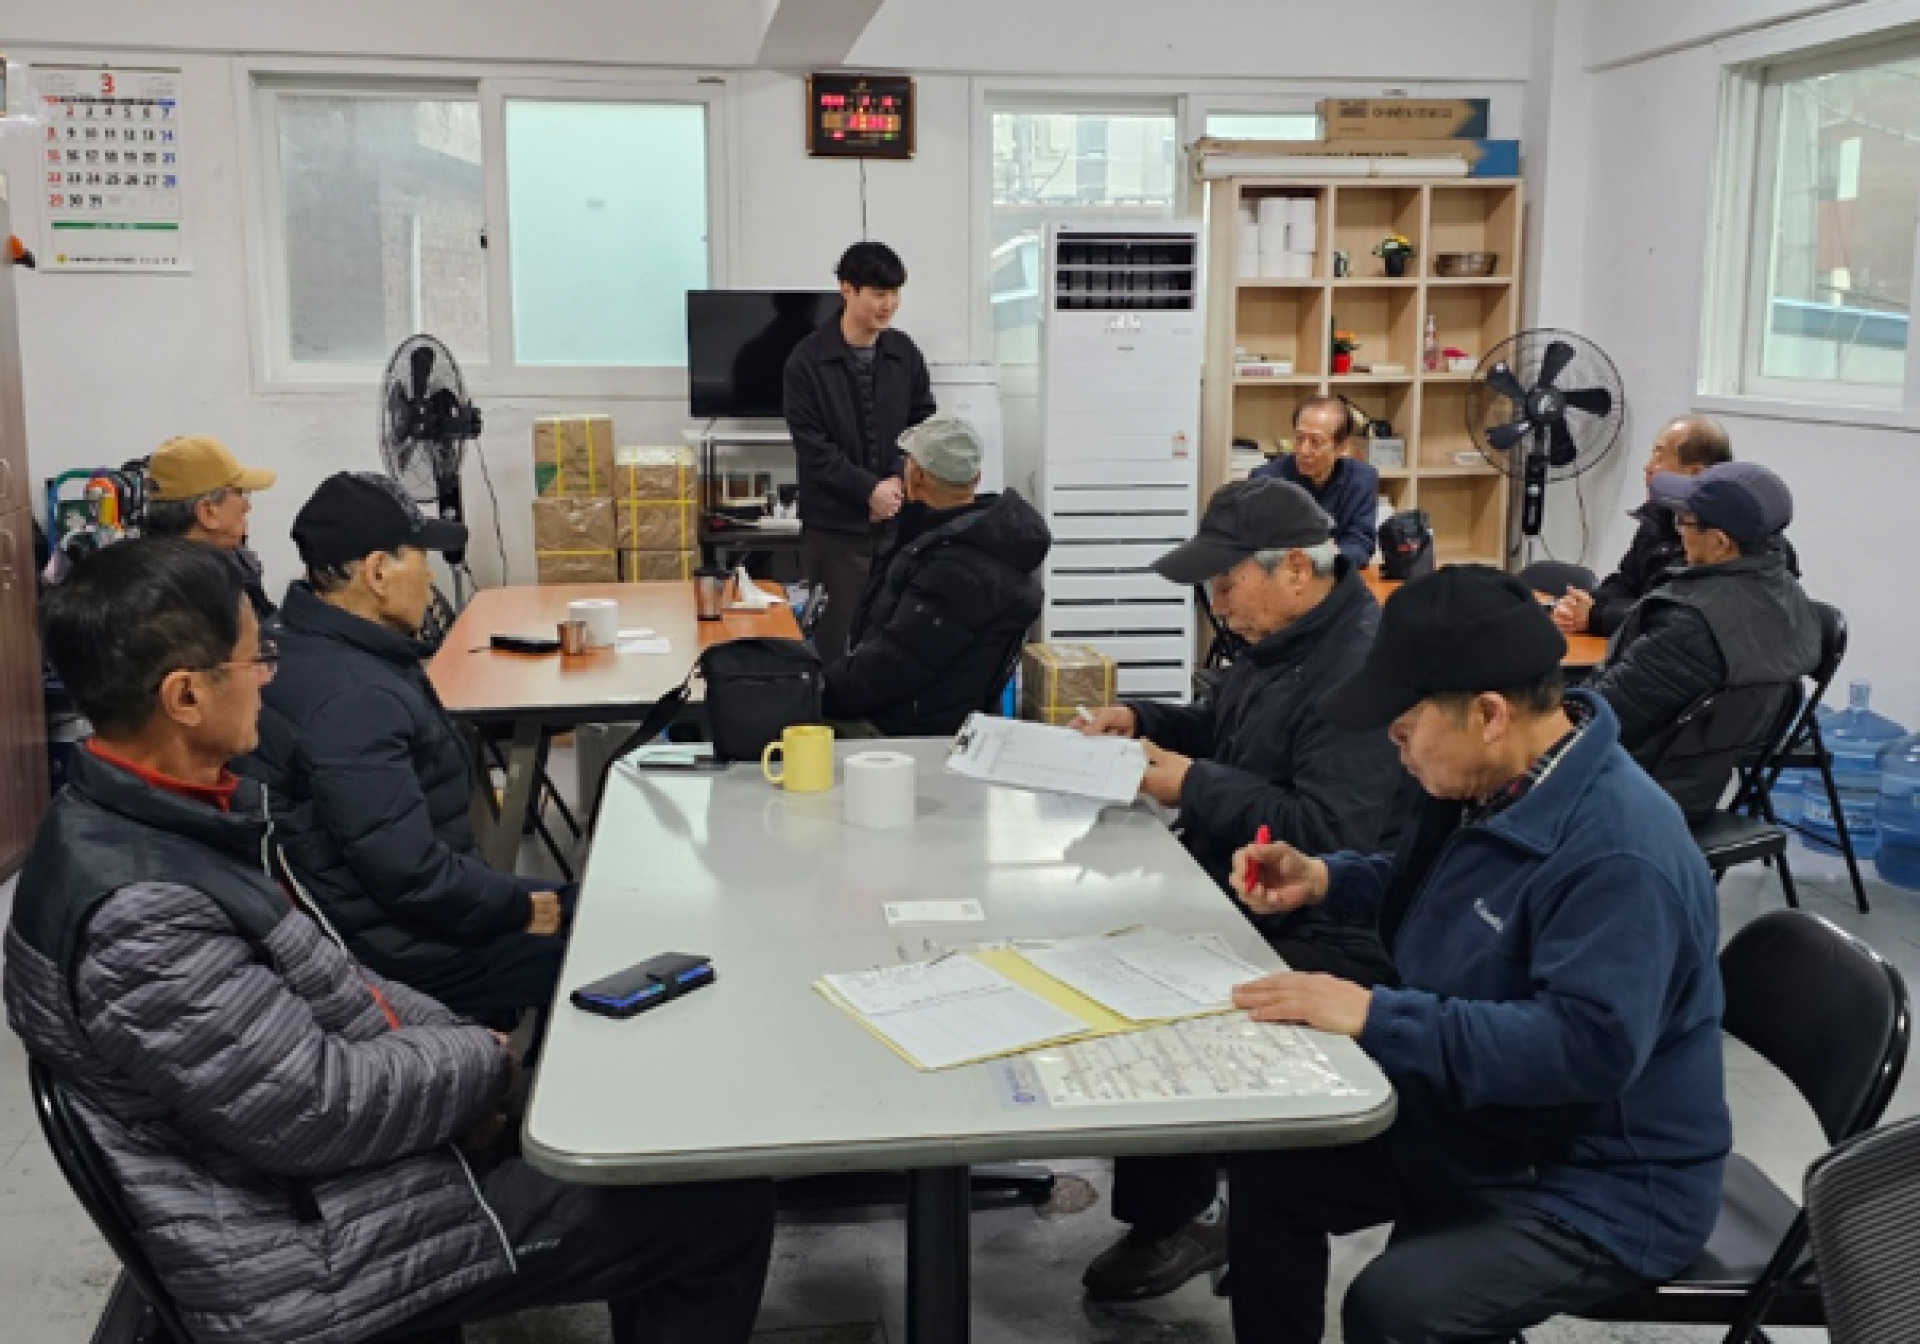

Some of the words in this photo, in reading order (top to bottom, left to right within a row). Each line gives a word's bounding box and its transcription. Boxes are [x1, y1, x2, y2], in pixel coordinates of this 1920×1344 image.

[100, 73, 115, 94] 3
[66, 106, 74, 117] 2
[86, 107, 93, 118] 3
[105, 107, 112, 118] 4
[124, 107, 131, 118] 5
[143, 107, 150, 118] 6
